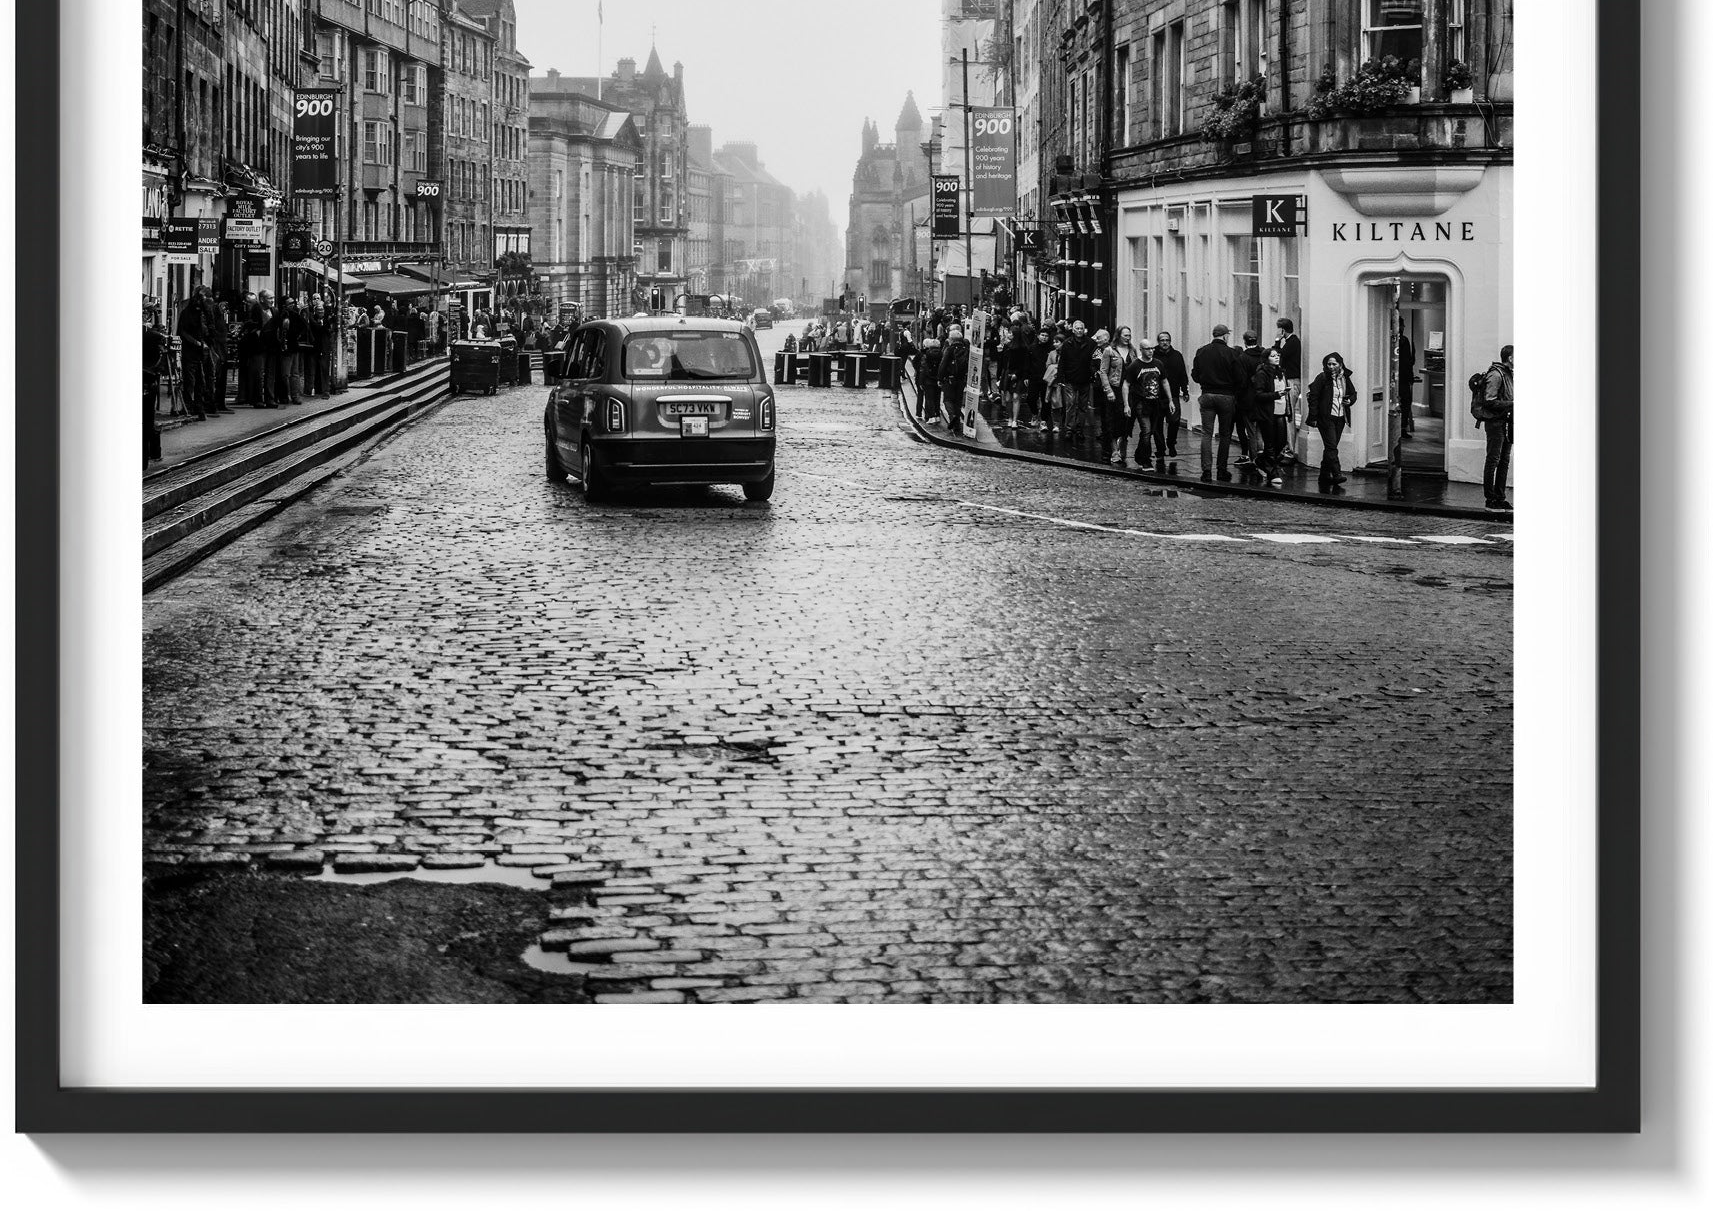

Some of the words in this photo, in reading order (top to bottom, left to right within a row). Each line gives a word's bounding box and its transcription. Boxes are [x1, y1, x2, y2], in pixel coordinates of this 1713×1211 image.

[296, 100, 333, 118] 900
[975, 119, 1011, 136] 900
[296, 135, 320, 143] Bringing
[982, 163, 1002, 171] history
[988, 172, 1012, 180] heritage
[417, 186, 439, 196] 900
[936, 182, 958, 192] 900
[1266, 200, 1284, 222] K
[1332, 222, 1474, 241] KILTANE
[1024, 232, 1034, 244] K
[670, 404, 695, 413] SC73
[697, 404, 716, 413] VKW
